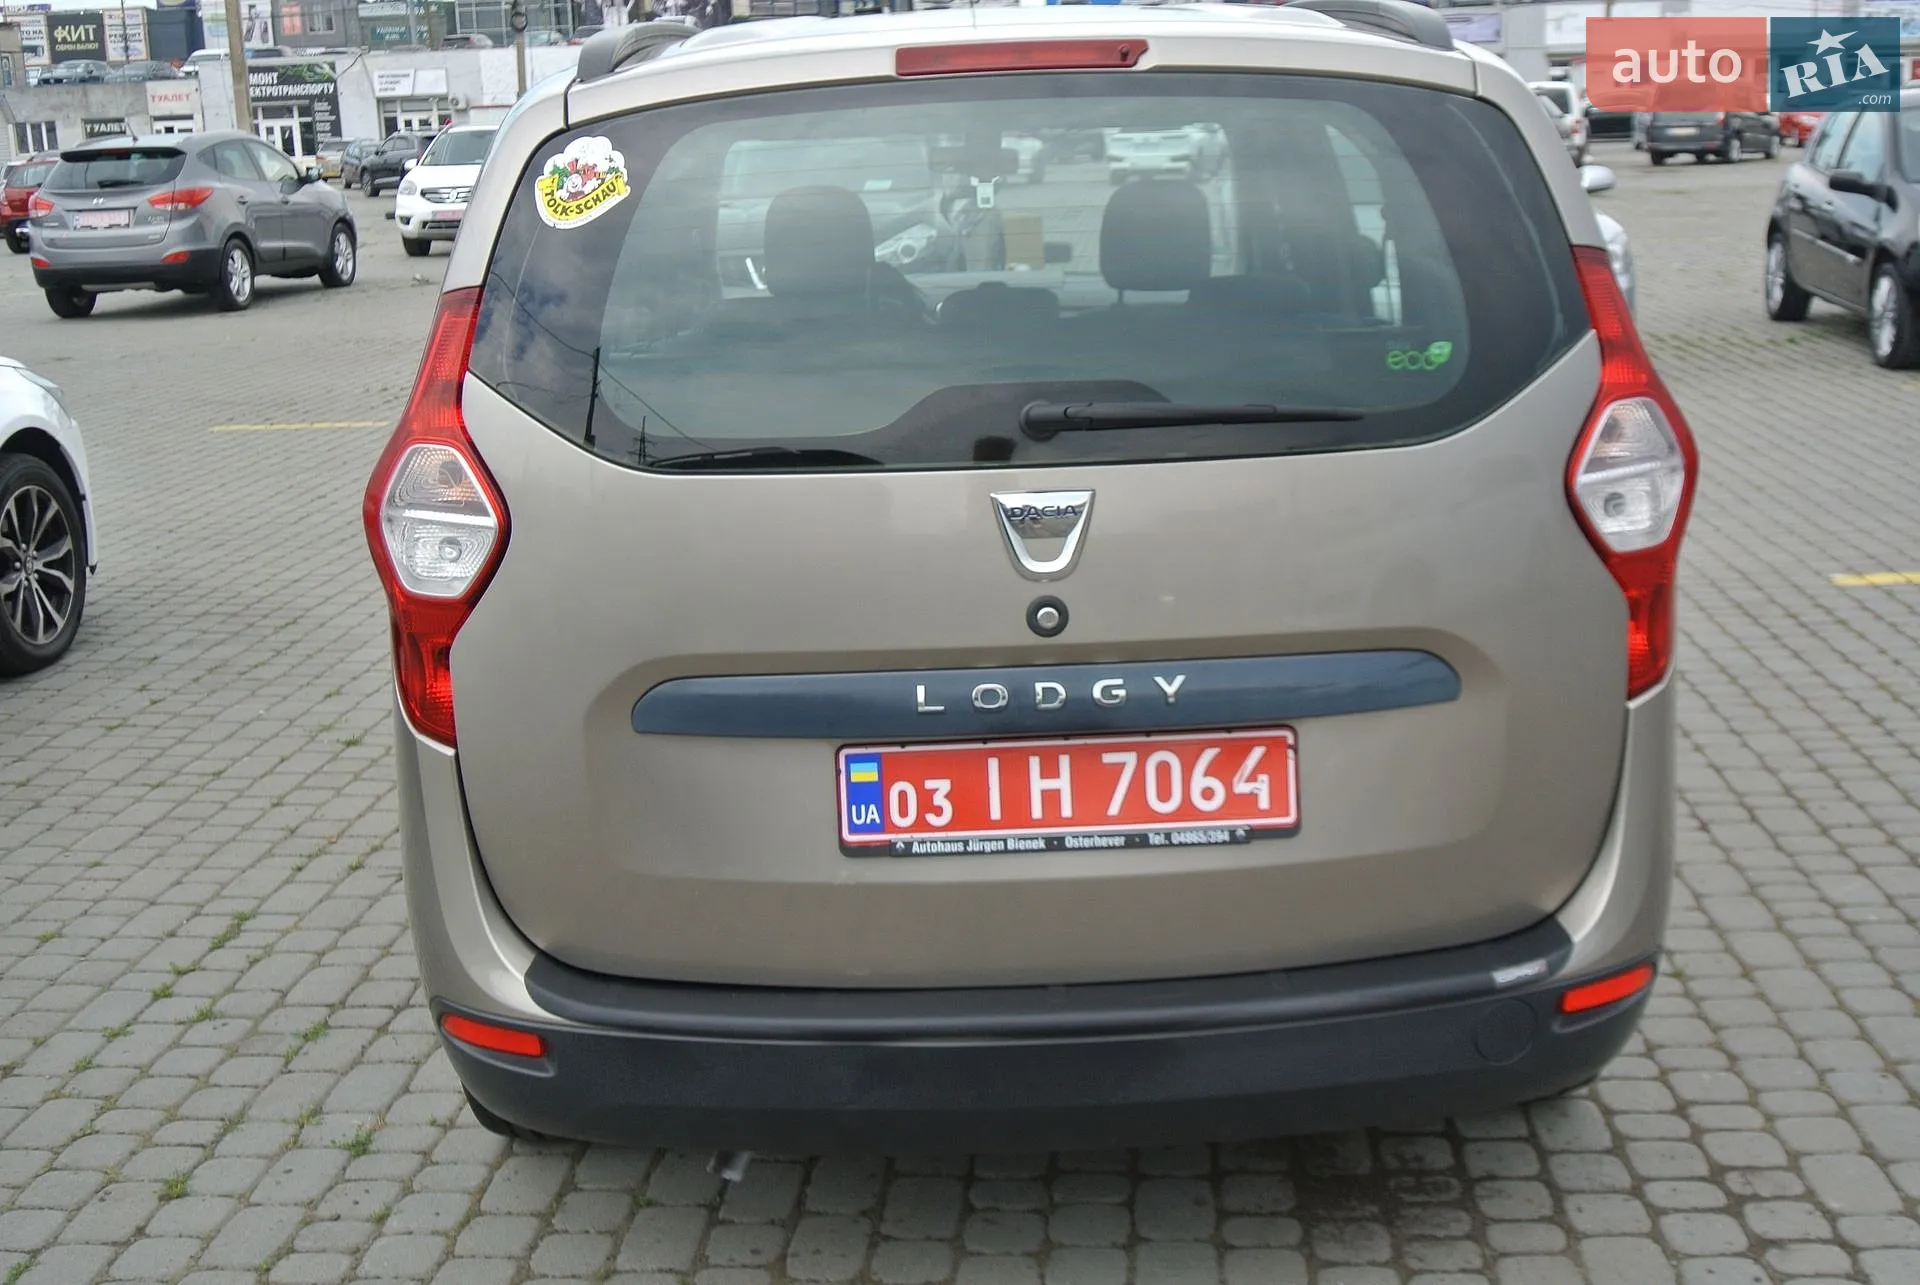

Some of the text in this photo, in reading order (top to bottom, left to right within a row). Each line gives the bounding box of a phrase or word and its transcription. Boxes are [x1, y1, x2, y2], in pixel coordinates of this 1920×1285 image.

[150, 92, 192, 103] ТУАЛЕТ
[85, 122, 127, 133] ТУАЛЕТ
[544, 181, 617, 217] TOLK-SCHAU
[1386, 350, 1440, 371] eco
[1008, 504, 1079, 520] DACIA
[915, 674, 1187, 713] LODGY
[889, 779, 953, 828] 03
[1101, 745, 1271, 817] 7064
[851, 804, 881, 825] UA
[911, 840, 965, 854] Autohaus
[967, 836, 1005, 853] Jürgen
[1006, 836, 1046, 851] Bienek
[1148, 832, 1169, 846] Tel.
